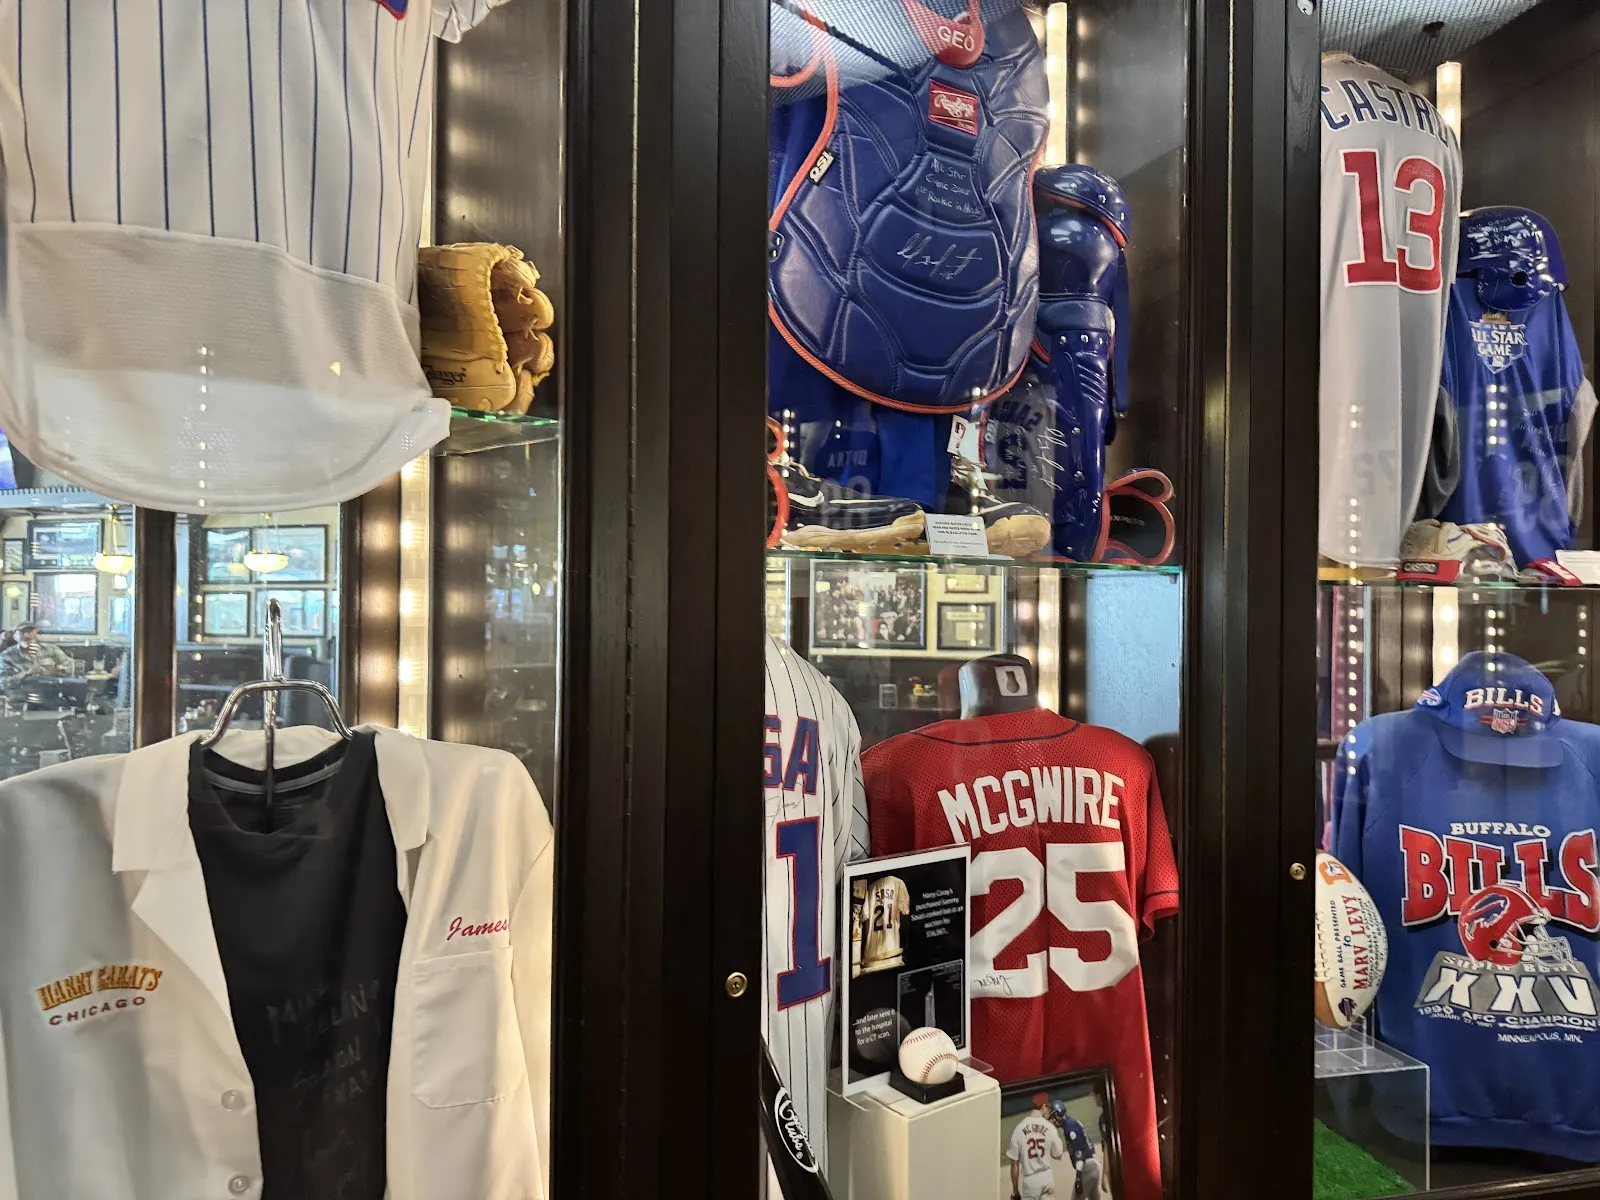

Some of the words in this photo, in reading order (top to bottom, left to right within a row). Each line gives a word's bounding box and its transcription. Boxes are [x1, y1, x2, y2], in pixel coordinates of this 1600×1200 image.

[937, 25, 975, 52] GEO
[1340, 149, 1446, 293] 13
[1477, 343, 1513, 356] GAME
[1404, 562, 1437, 573] CASTRO
[1464, 687, 1544, 716] BILLS
[937, 766, 1125, 843] MCGWIRE
[1450, 821, 1551, 838] BUFFALO
[1399, 824, 1600, 933] BILLS
[446, 916, 507, 941] James
[873, 903, 893, 932] 21
[970, 842, 1139, 999] 25
[1329, 900, 1342, 942] PRESENTED
[1341, 895, 1366, 936] LEVY
[1339, 967, 1347, 988] GAME
[1352, 945, 1369, 990] MARV
[36, 970, 93, 1011] HARRY
[1421, 966, 1598, 1016] XXV
[49, 996, 146, 1025] CHICAGO
[871, 1019, 893, 1031] hospital
[1418, 1005, 1454, 1016] 1990
[1462, 1010, 1497, 1023] AFC
[1506, 1015, 1600, 1027] CHAMPION
[1027, 1138, 1046, 1159] 25
